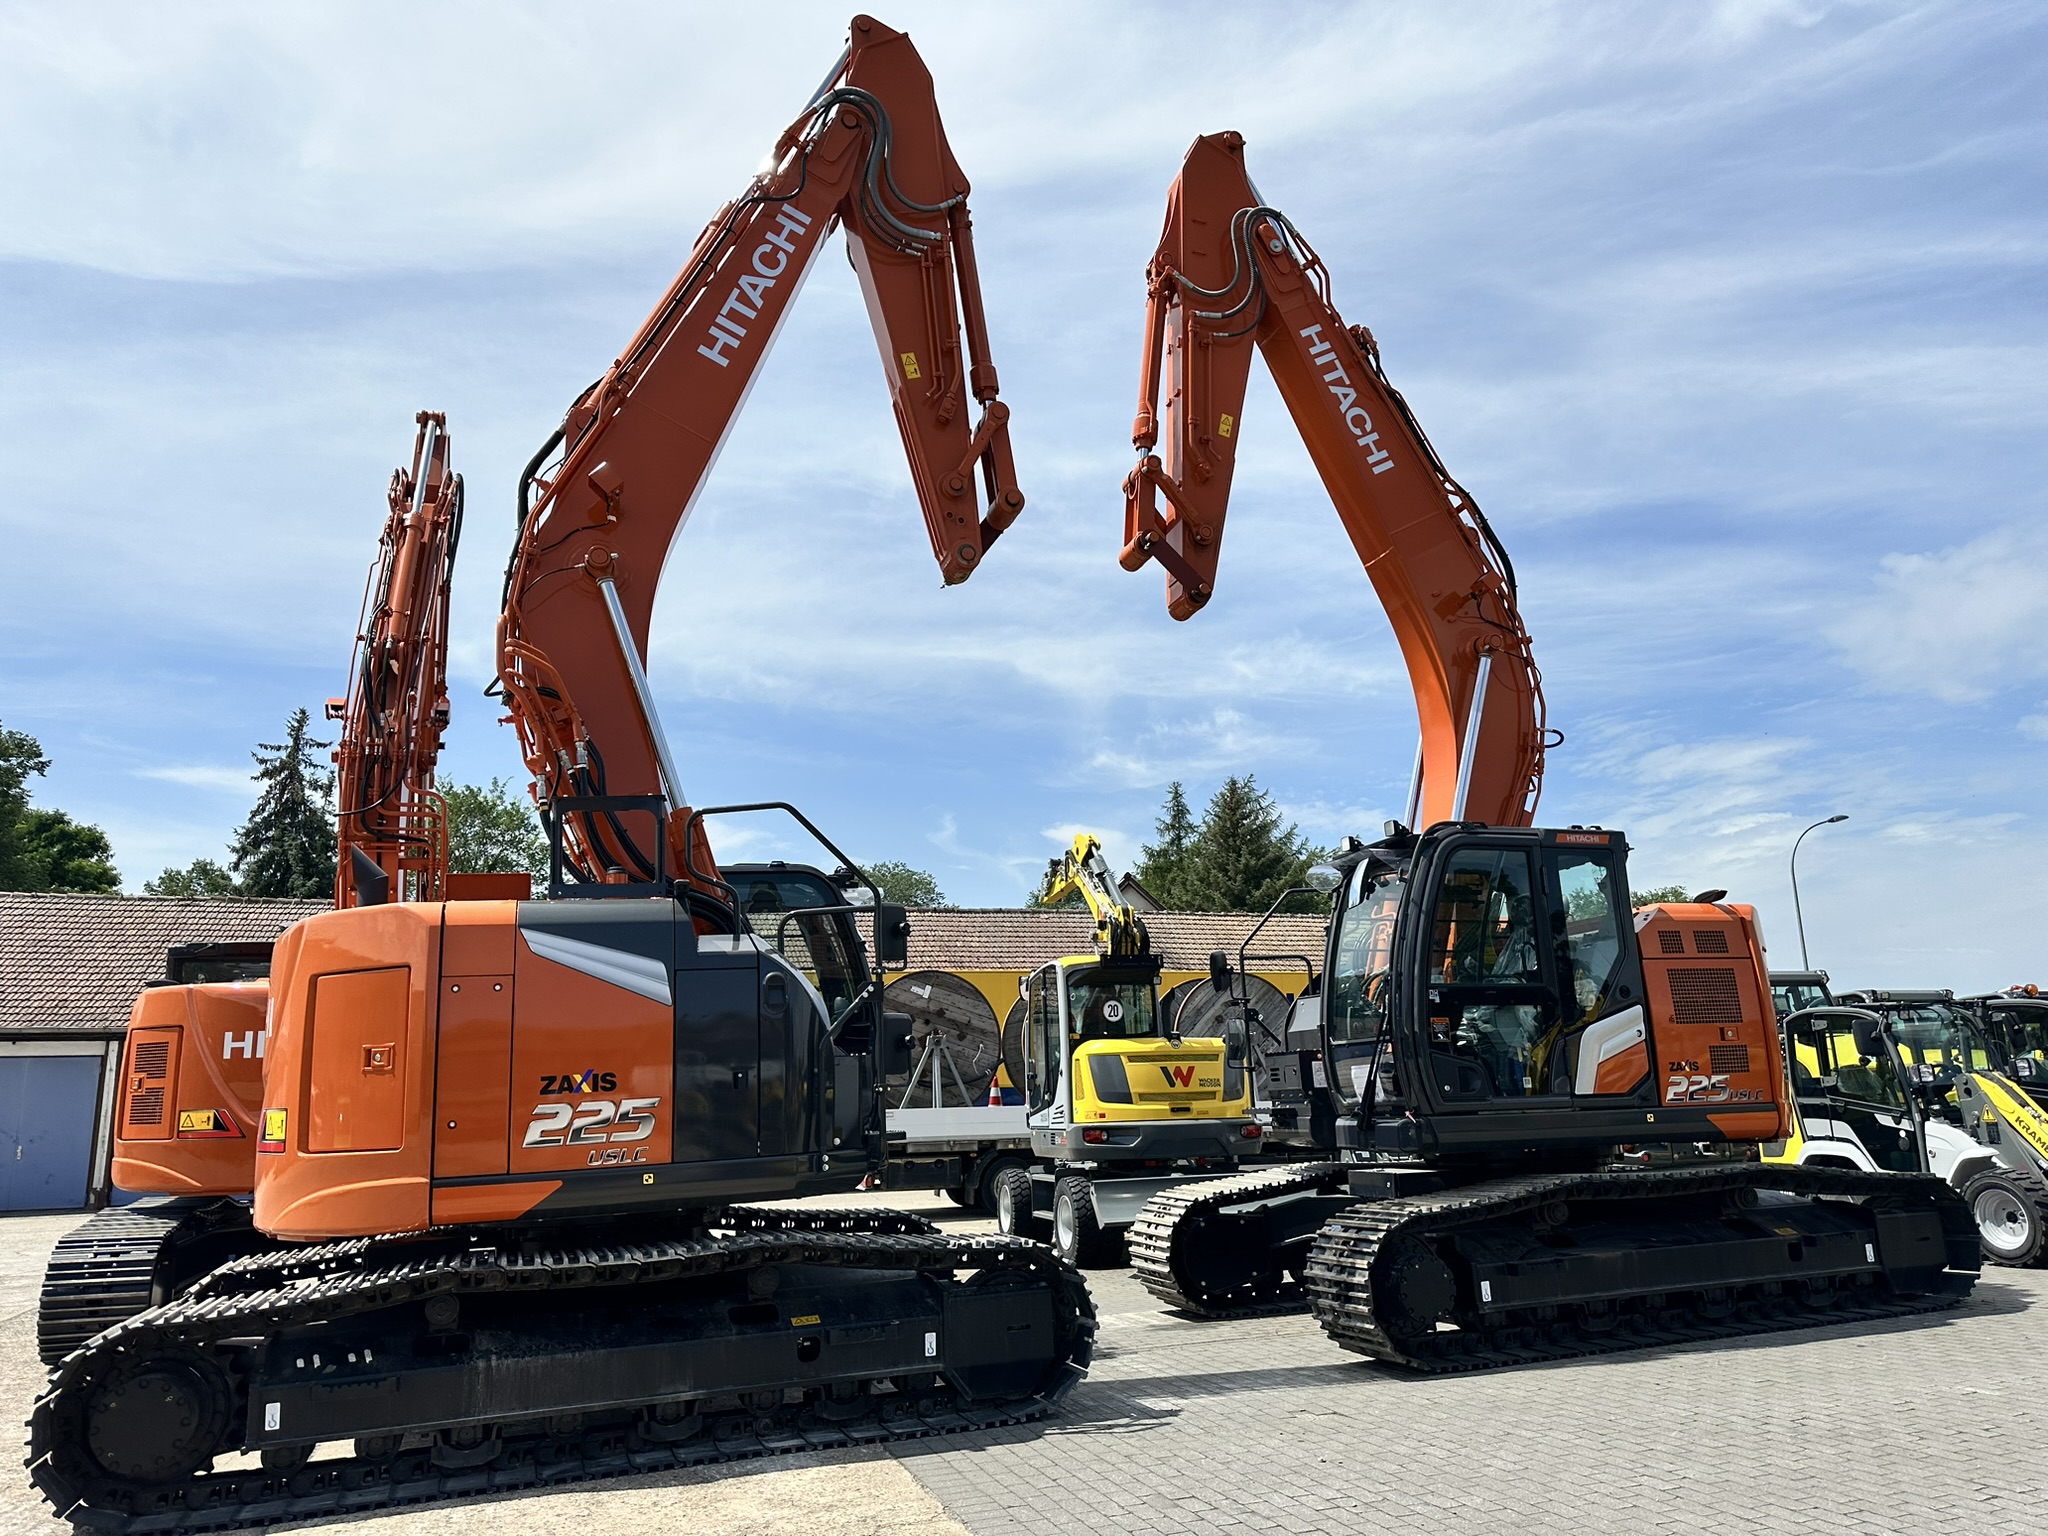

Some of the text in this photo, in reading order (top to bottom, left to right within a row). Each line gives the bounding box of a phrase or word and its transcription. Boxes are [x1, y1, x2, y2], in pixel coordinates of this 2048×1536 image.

[697, 203, 812, 367] HITACHI
[1300, 323, 1394, 475] HITACHI
[1566, 834, 1600, 843] HITACHI
[1107, 1004, 1119, 1017] 20
[1669, 1059, 1699, 1072] ZAXIS
[540, 1069, 617, 1095] ZAXIS
[1666, 1074, 1730, 1103] 225
[522, 1096, 662, 1149] 225
[587, 1146, 649, 1166] USLC
